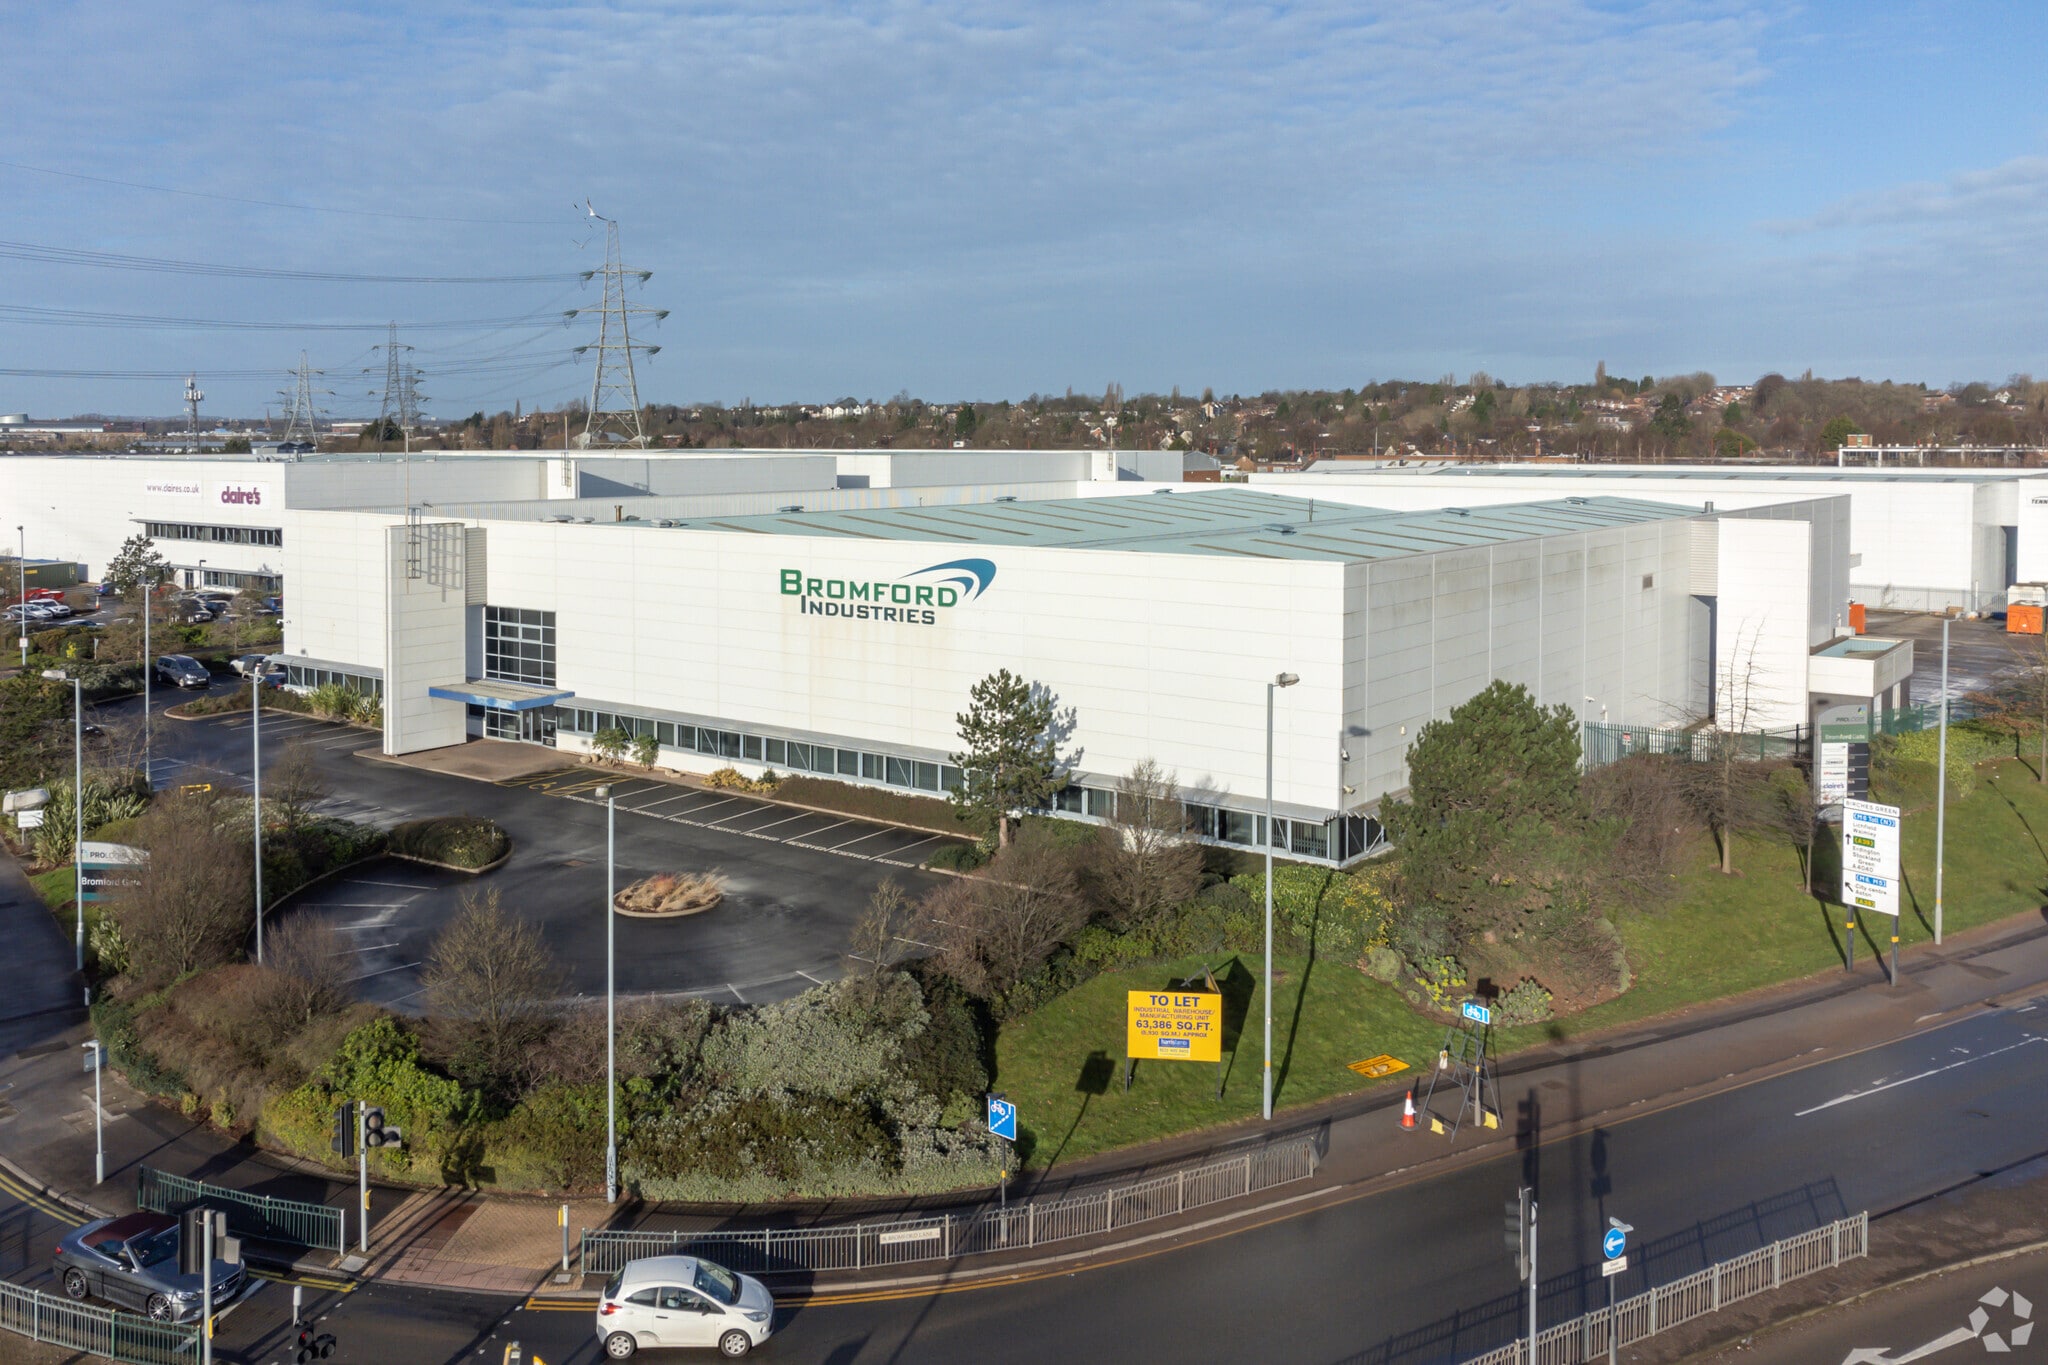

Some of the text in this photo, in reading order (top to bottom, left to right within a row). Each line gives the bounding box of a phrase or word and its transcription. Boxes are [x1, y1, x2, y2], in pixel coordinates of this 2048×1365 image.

[221, 486, 261, 505] claire's
[780, 568, 958, 608] BROMFORD
[800, 594, 936, 625] INDUSTRIES
[1846, 800, 1898, 815] BIRCHES GREEN
[1853, 852, 1881, 862] Stockland
[1149, 995, 1201, 1007] TO LET
[1136, 1019, 1214, 1031] 63,386 SQ.FT.
